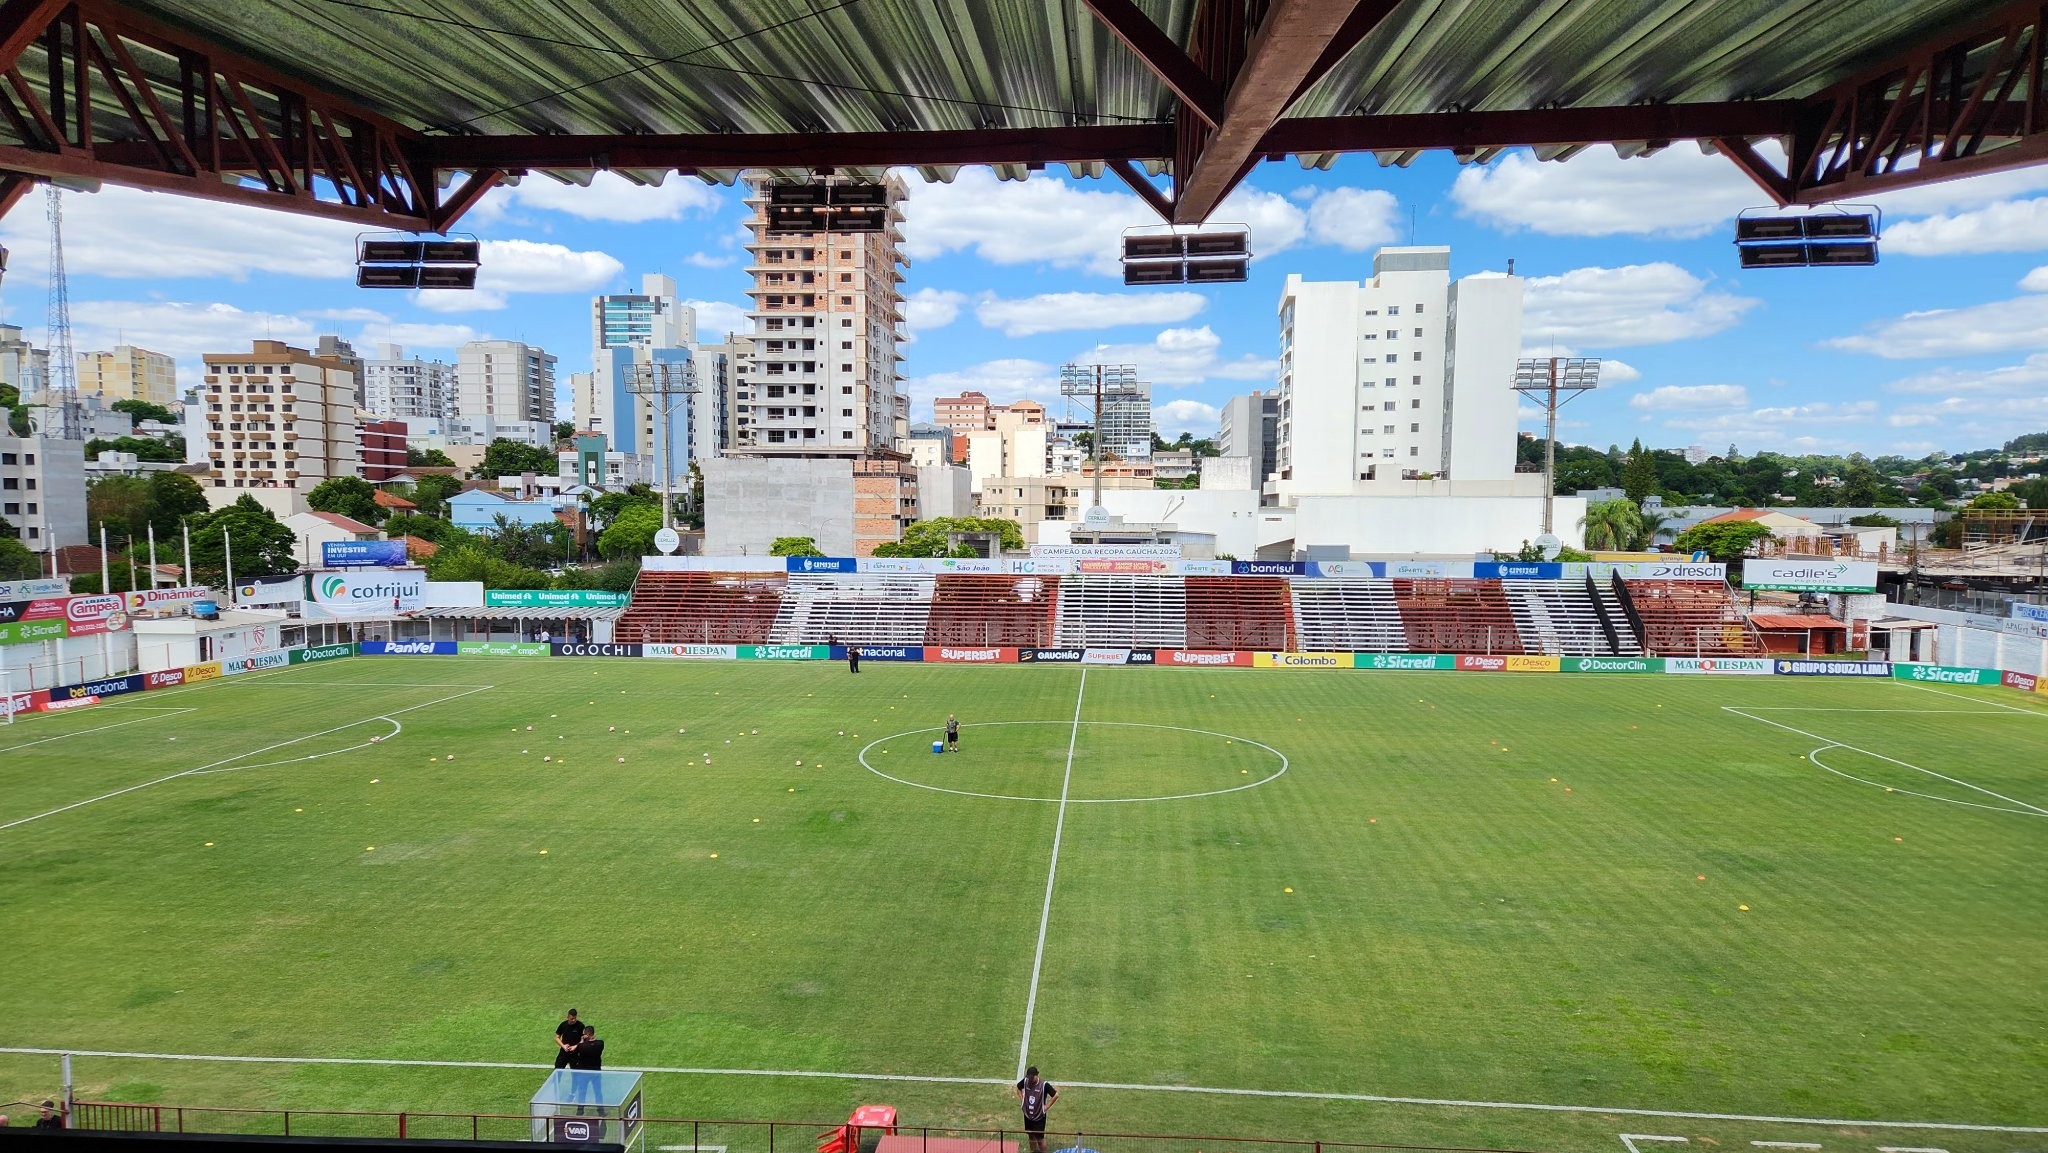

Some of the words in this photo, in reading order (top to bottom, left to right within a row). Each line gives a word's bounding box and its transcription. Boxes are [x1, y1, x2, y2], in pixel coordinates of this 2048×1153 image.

[328, 546, 367, 554] INVESTIR
[1043, 547, 1080, 555] CAMPEÃO
[1126, 547, 1158, 555] GAÚCHA
[1251, 564, 1294, 573] banrisul
[1671, 565, 1721, 577] dresch
[1772, 568, 1838, 579] cadile's
[147, 589, 206, 603] Dinâmica
[352, 582, 419, 599] cotrijui
[32, 624, 61, 636] Sicredi
[312, 647, 349, 659] DoctorClin
[462, 646, 483, 655] cmpc
[490, 646, 511, 655] cmpc
[518, 647, 539, 656] cmpc
[562, 644, 631, 655] OGOCHI
[651, 645, 728, 656] MARQUESPAN
[767, 647, 812, 658] Sicredi
[941, 648, 1001, 661] SUPERBET
[1087, 652, 1125, 660] SUPERBET
[1132, 653, 1152, 661] 2026
[1173, 652, 1235, 665] SUPERBET
[1285, 655, 1337, 666] Colombo
[1387, 656, 1436, 668] Sicredi
[1475, 657, 1505, 666] Desco
[228, 655, 284, 672] MARQUESPAN
[1522, 658, 1551, 667] Desco
[1593, 659, 1647, 671] DoctorClin
[1675, 660, 1764, 671] MARQUESPAN
[196, 666, 216, 675] Desco
[1792, 662, 1826, 673] GRUPO
[1827, 662, 1862, 674] SOUZA
[1863, 663, 1889, 675] LIMA
[160, 672, 182, 682] Desco
[1926, 666, 1980, 683] Sicredi
[2014, 674, 2035, 687] Desco
[70, 679, 129, 698] betnacional
[48, 699, 95, 709] SUPERBET
[568, 1127, 587, 1135] VAR
